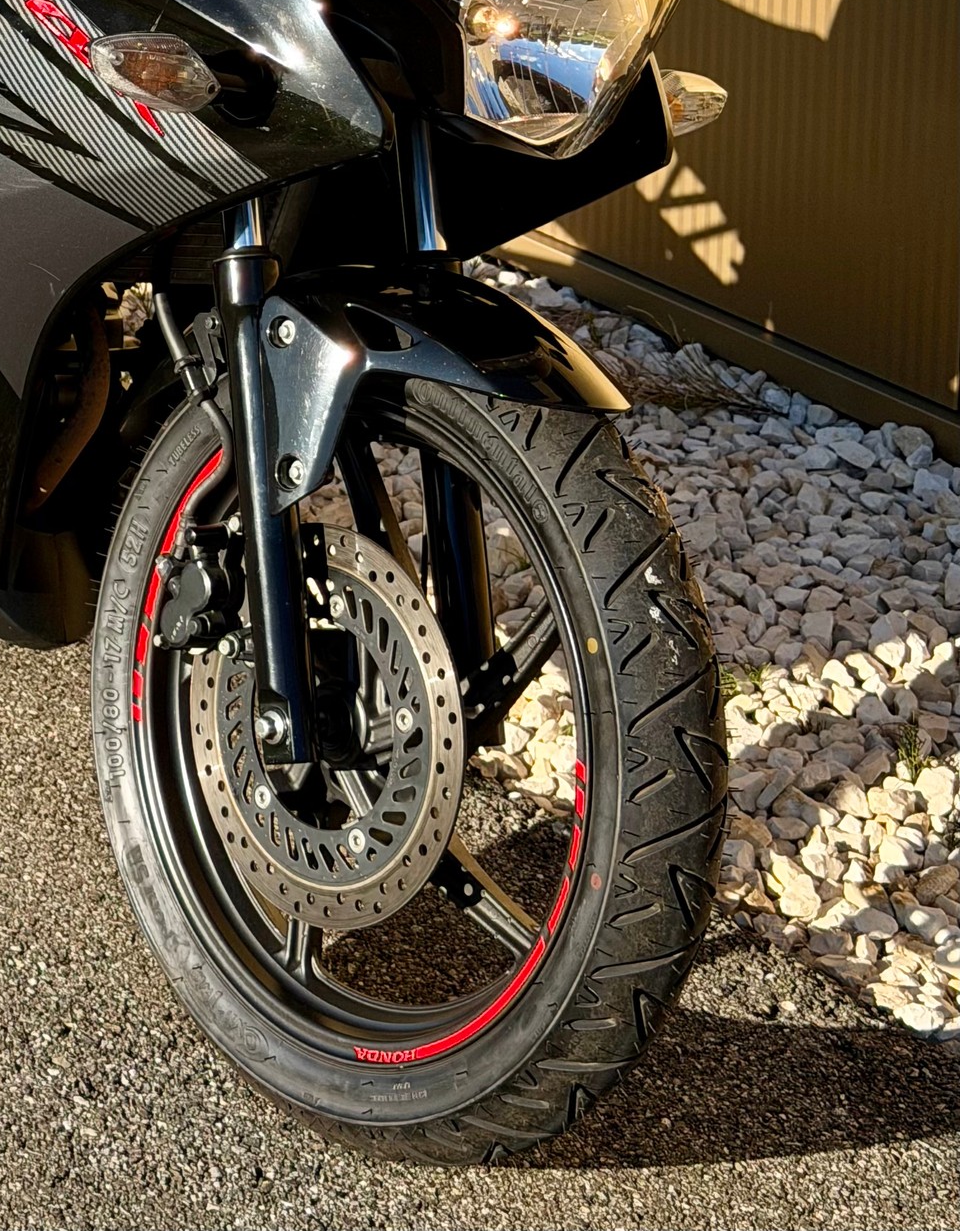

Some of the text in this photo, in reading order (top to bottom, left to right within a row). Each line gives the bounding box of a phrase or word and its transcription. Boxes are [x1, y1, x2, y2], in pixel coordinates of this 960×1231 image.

[168, 424, 201, 467] TUBELESS
[122, 518, 148, 566] 52H
[354, 1046, 417, 1063] HONDA
